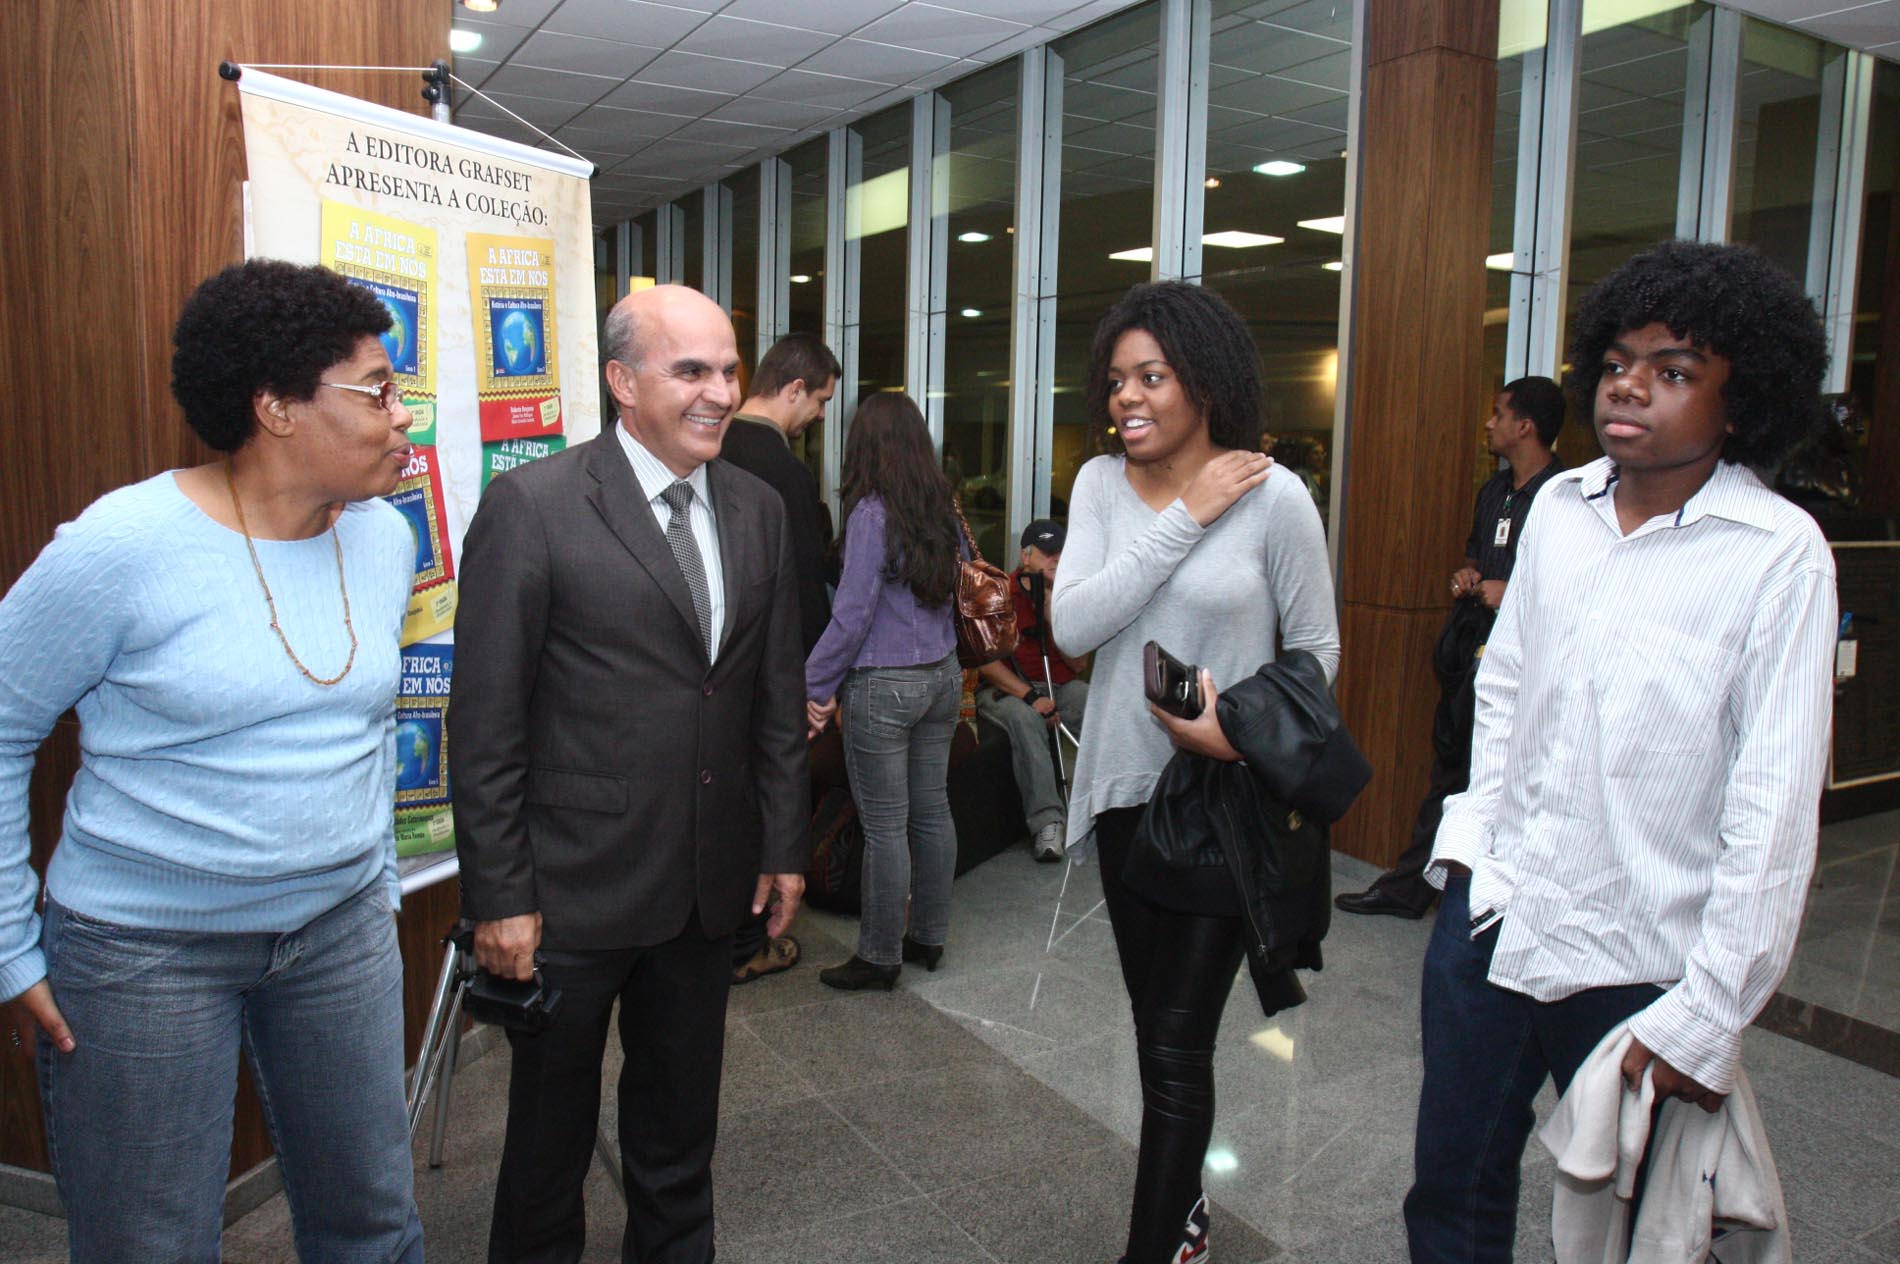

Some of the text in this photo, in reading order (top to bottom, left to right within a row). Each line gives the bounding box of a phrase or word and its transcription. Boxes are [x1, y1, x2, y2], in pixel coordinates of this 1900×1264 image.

[346, 131, 532, 192] A EDITORA GRAFSET
[326, 163, 548, 227] APRESENTA A COLEÇÃO:
[349, 220, 360, 241] A
[375, 250, 396, 272] EM
[488, 247, 497, 265] A
[509, 268, 526, 286] EM
[491, 453, 517, 471] ESTÁ
[401, 656, 441, 674] FRICA
[402, 673, 451, 695] EM NÓS
